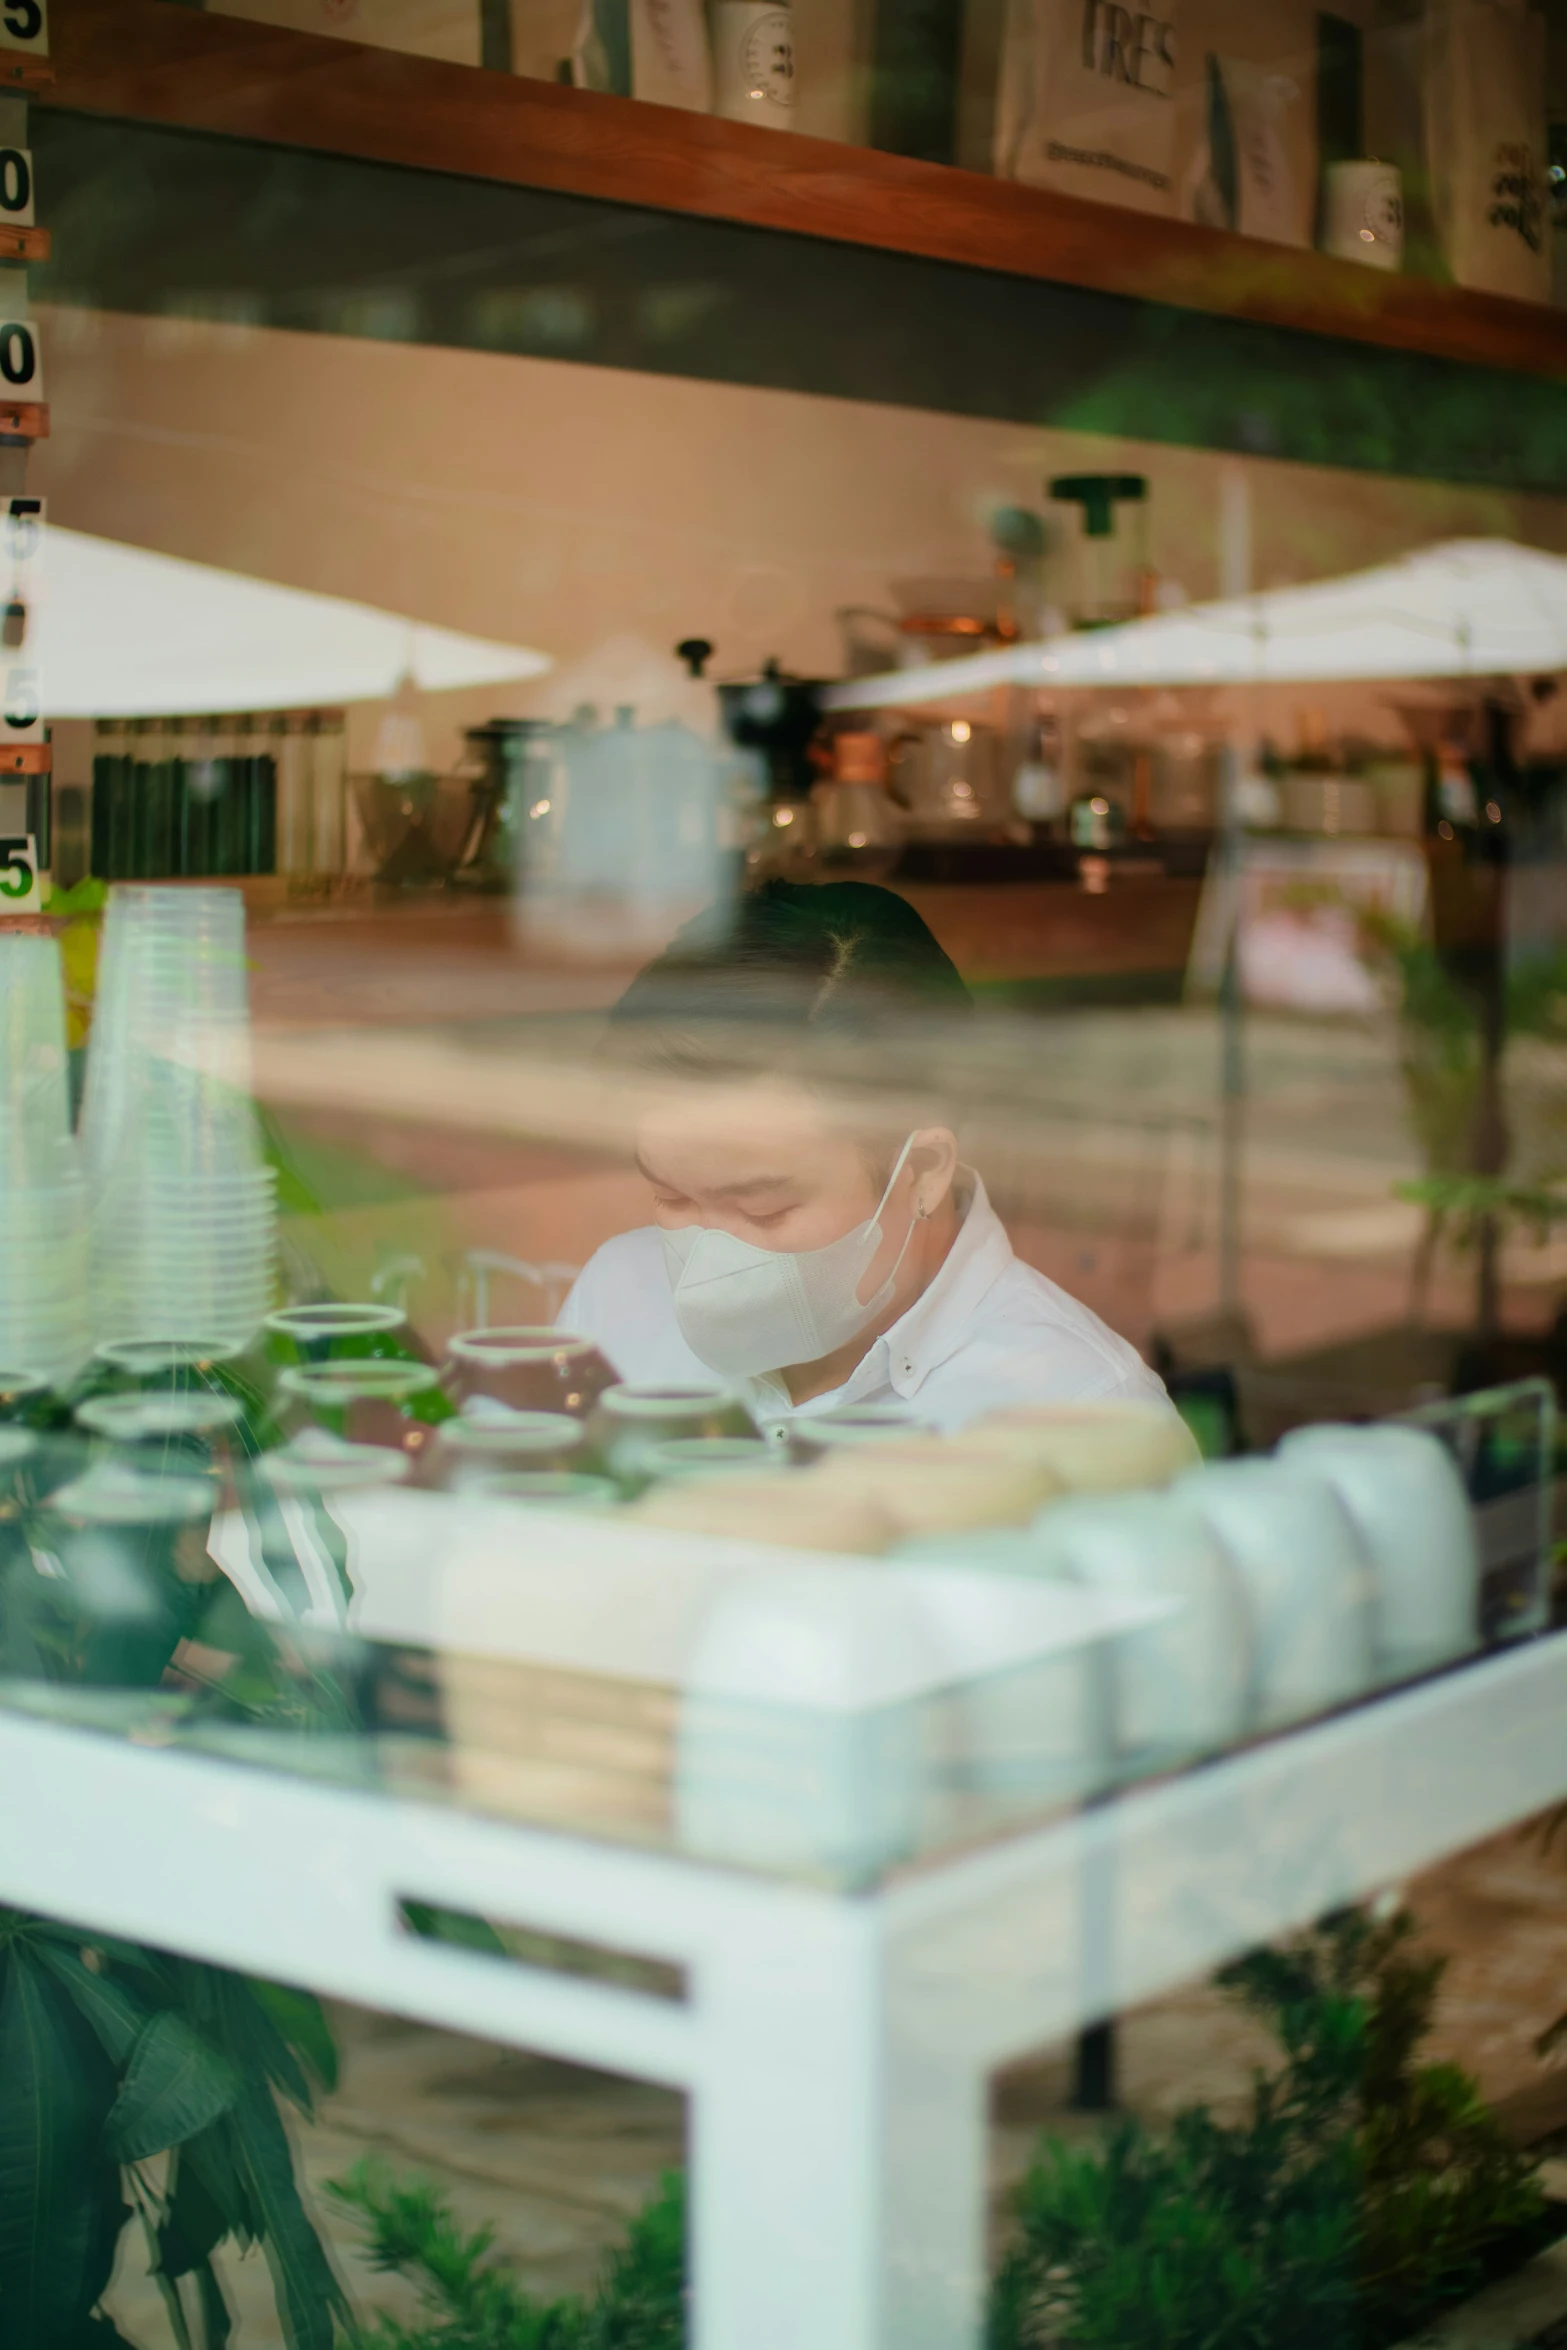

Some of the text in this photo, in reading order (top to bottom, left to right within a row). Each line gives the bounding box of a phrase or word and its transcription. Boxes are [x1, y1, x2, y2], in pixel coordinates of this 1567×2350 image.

[0, 149, 29, 211] 0
[0, 323, 35, 385] 0
[4, 499, 40, 560] 5
[4, 669, 39, 728] 5
[0, 839, 33, 897] 5
